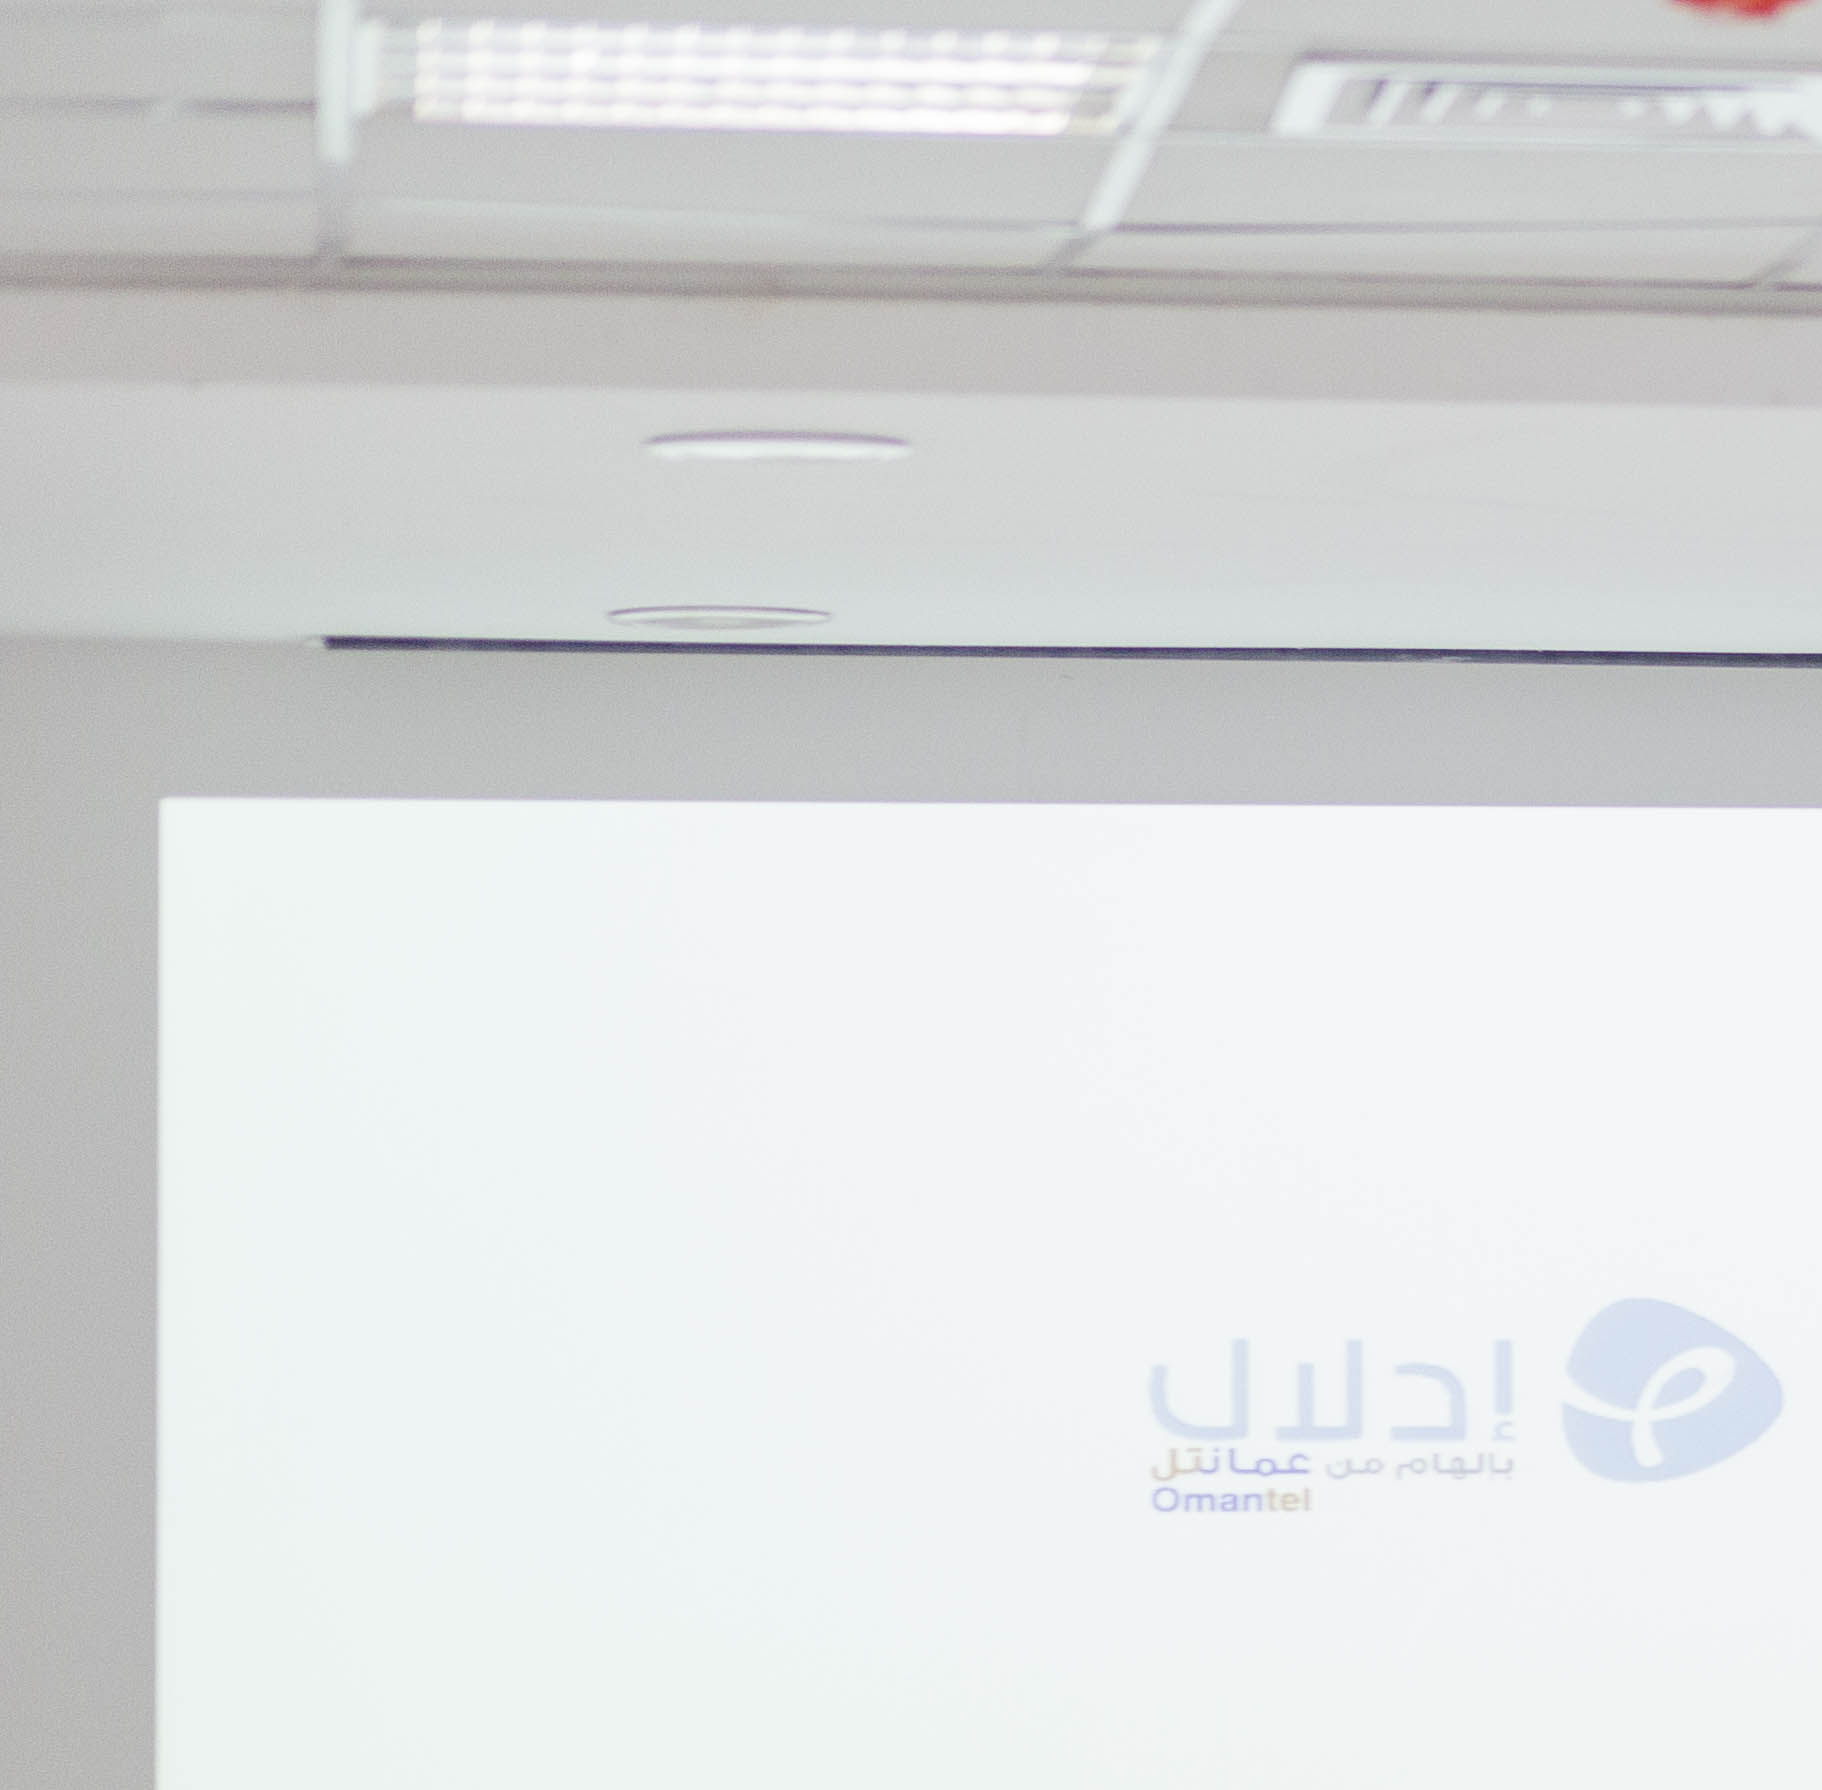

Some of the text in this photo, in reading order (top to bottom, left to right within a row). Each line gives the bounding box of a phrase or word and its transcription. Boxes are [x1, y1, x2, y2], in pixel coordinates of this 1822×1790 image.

[1151, 1448, 1311, 1481] عمانتل
[1326, 1458, 1385, 1480] من
[1152, 1487, 1311, 1513] Omantel
